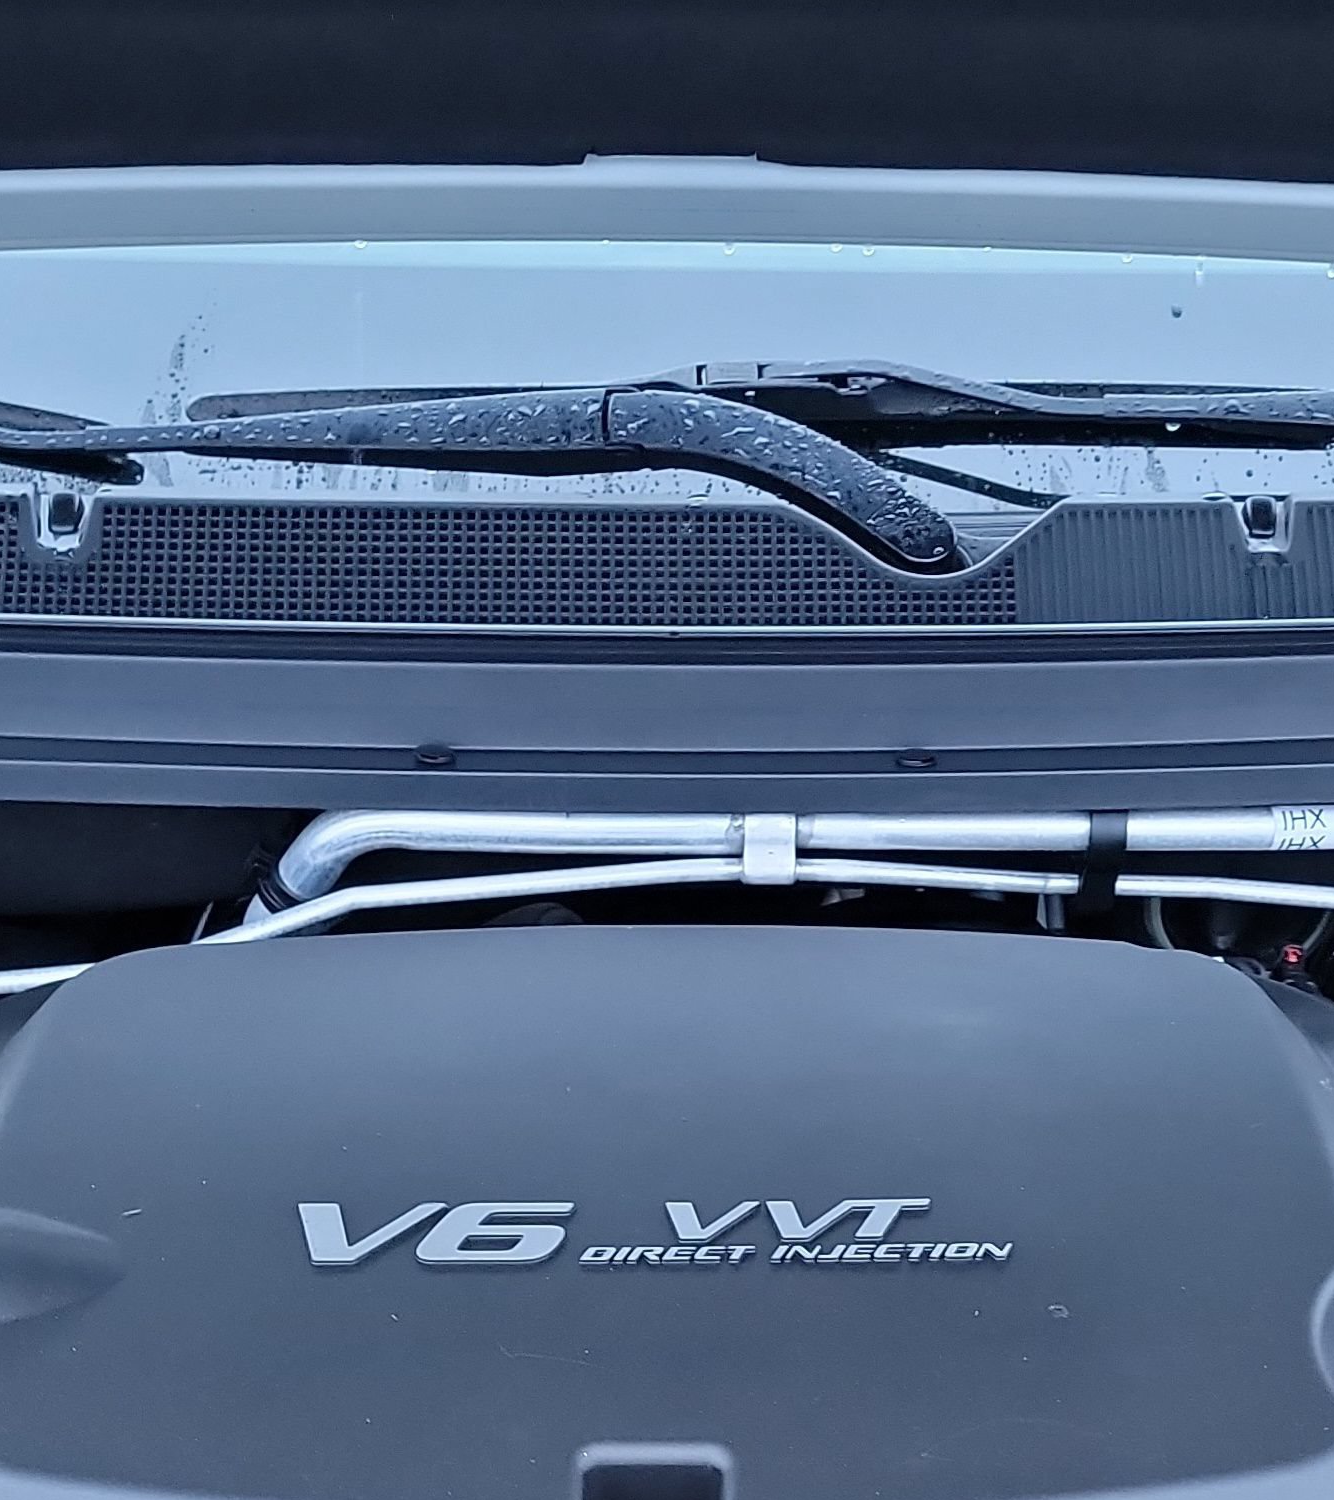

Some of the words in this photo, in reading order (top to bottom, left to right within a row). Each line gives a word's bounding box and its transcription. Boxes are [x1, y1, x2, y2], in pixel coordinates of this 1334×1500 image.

[1281, 808, 1327, 831] IHX
[297, 1201, 576, 1266] V6
[665, 1197, 931, 1244] VVT
[579, 1244, 756, 1264] DIRECT
[769, 1241, 1014, 1264] INJECTION
